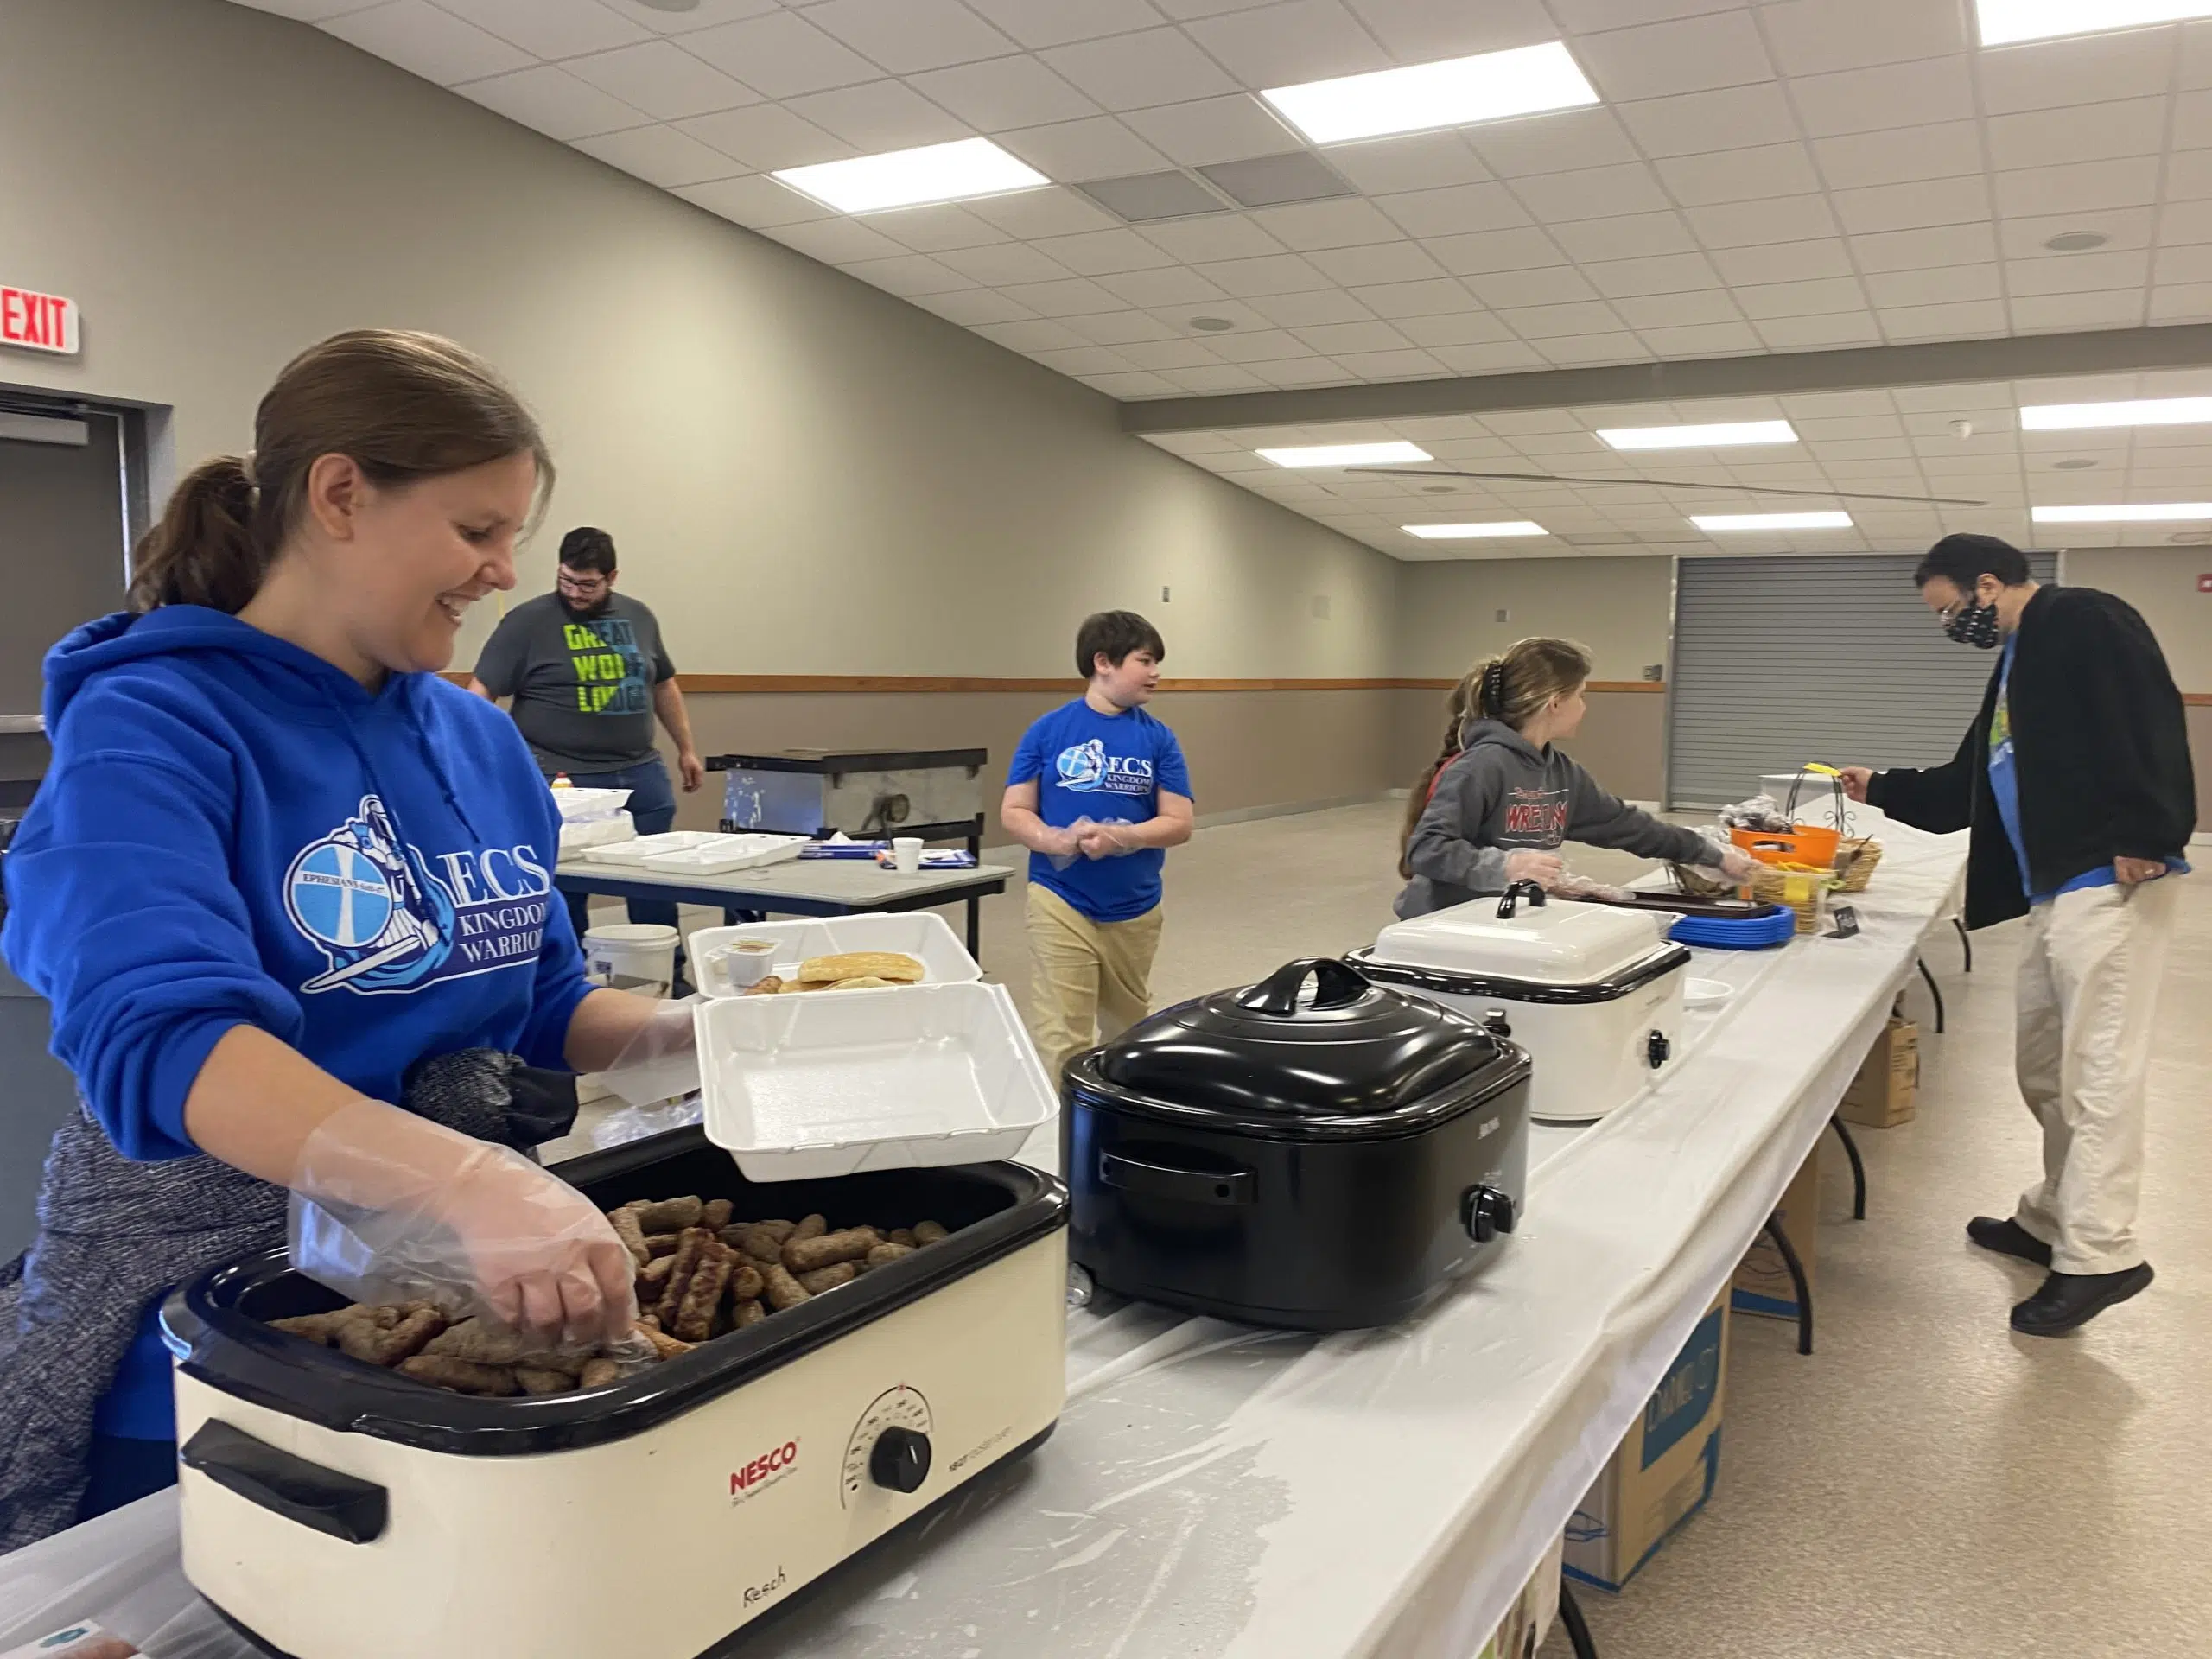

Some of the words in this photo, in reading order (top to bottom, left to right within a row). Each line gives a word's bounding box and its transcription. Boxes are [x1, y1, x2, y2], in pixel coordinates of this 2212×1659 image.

[3, 289, 67, 347] EXIT
[1107, 756, 1152, 778] ECS
[302, 874, 358, 889] EPHESIANS
[435, 844, 550, 908] ECS
[730, 1440, 797, 1496] NESCO
[743, 1564, 787, 1609] Resch
